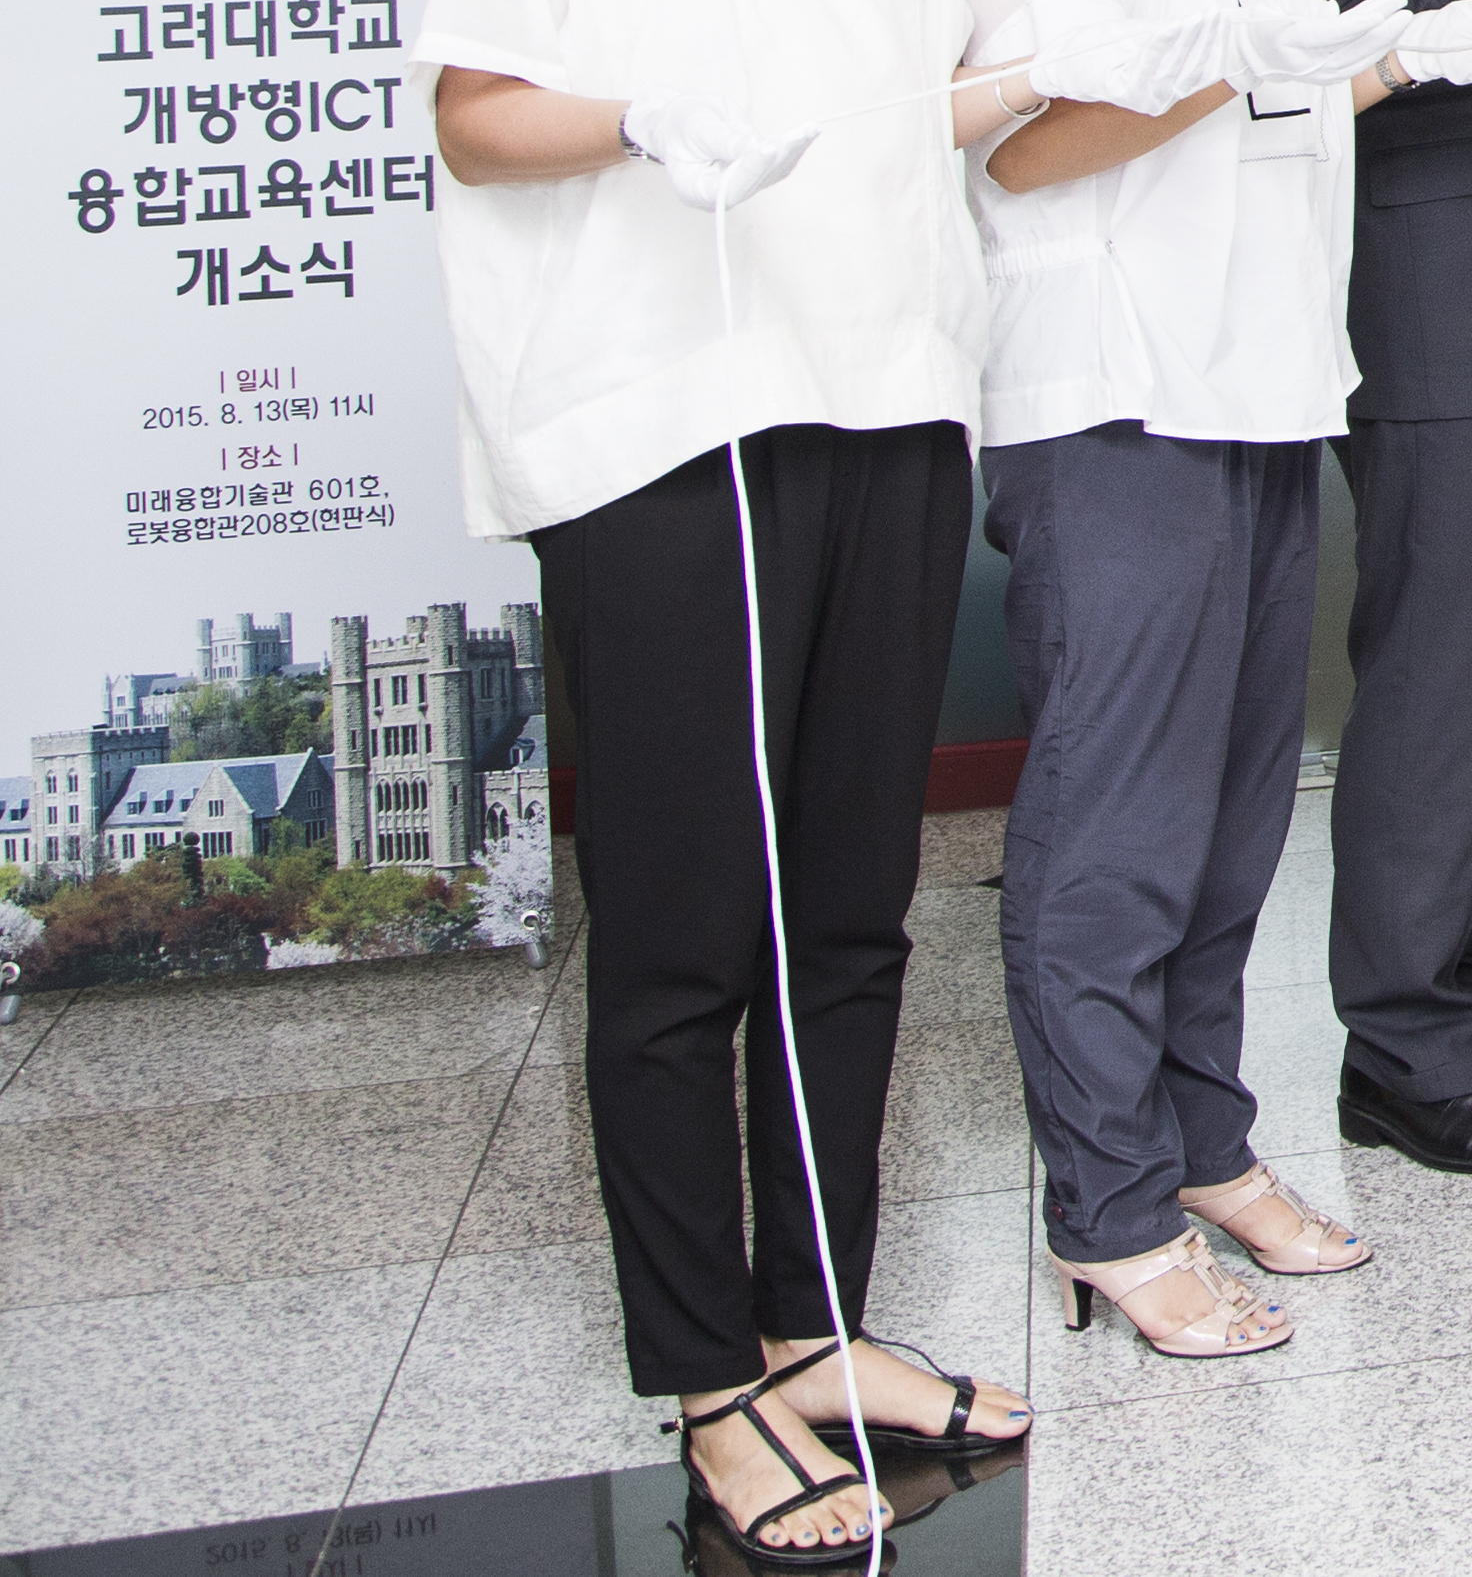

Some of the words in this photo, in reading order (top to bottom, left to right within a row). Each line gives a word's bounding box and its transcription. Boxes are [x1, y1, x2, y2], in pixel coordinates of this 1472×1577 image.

[123, 77, 402, 144] 개방형ICT
[68, 154, 434, 234] 융합교육센터
[176, 240, 354, 306] 개소식
[236, 367, 279, 392] 일시
[143, 407, 208, 429] 2015.
[221, 404, 242, 424] 8.
[254, 396, 318, 423] 13(목)
[330, 394, 374, 417] 11시
[238, 445, 282, 470] 장소
[126, 483, 293, 514] 미래융합기술관
[308, 475, 389, 501] 601호,
[127, 503, 395, 546] 로봇융합관208호(현판식)
